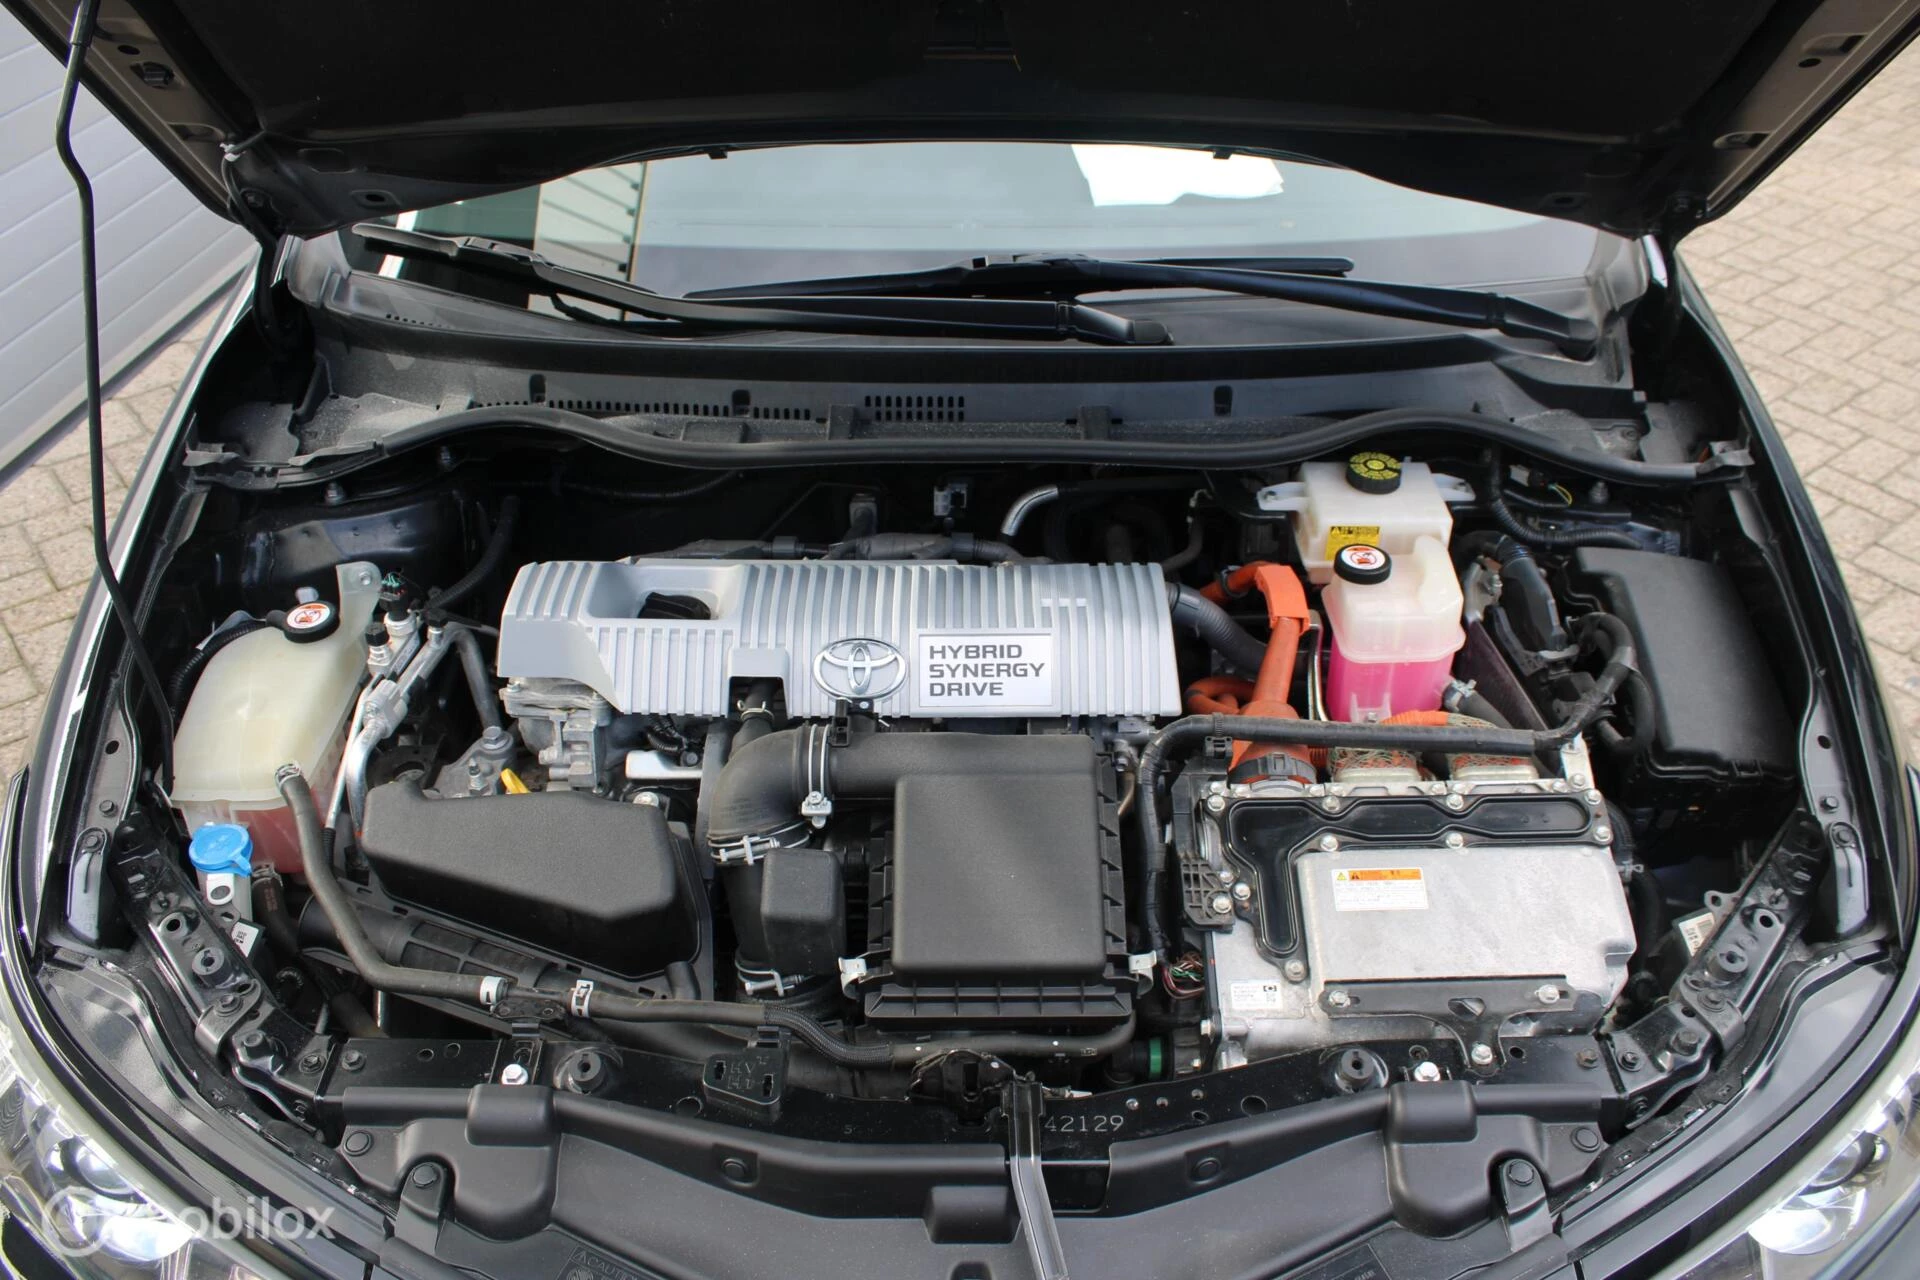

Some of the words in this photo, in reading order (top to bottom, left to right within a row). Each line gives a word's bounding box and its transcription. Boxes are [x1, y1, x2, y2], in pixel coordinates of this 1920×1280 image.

[929, 644, 1023, 659] HYBRID
[929, 662, 1045, 678] SYNERGY
[929, 682, 1004, 697] DRIVE
[1044, 1114, 1124, 1132] 42129
